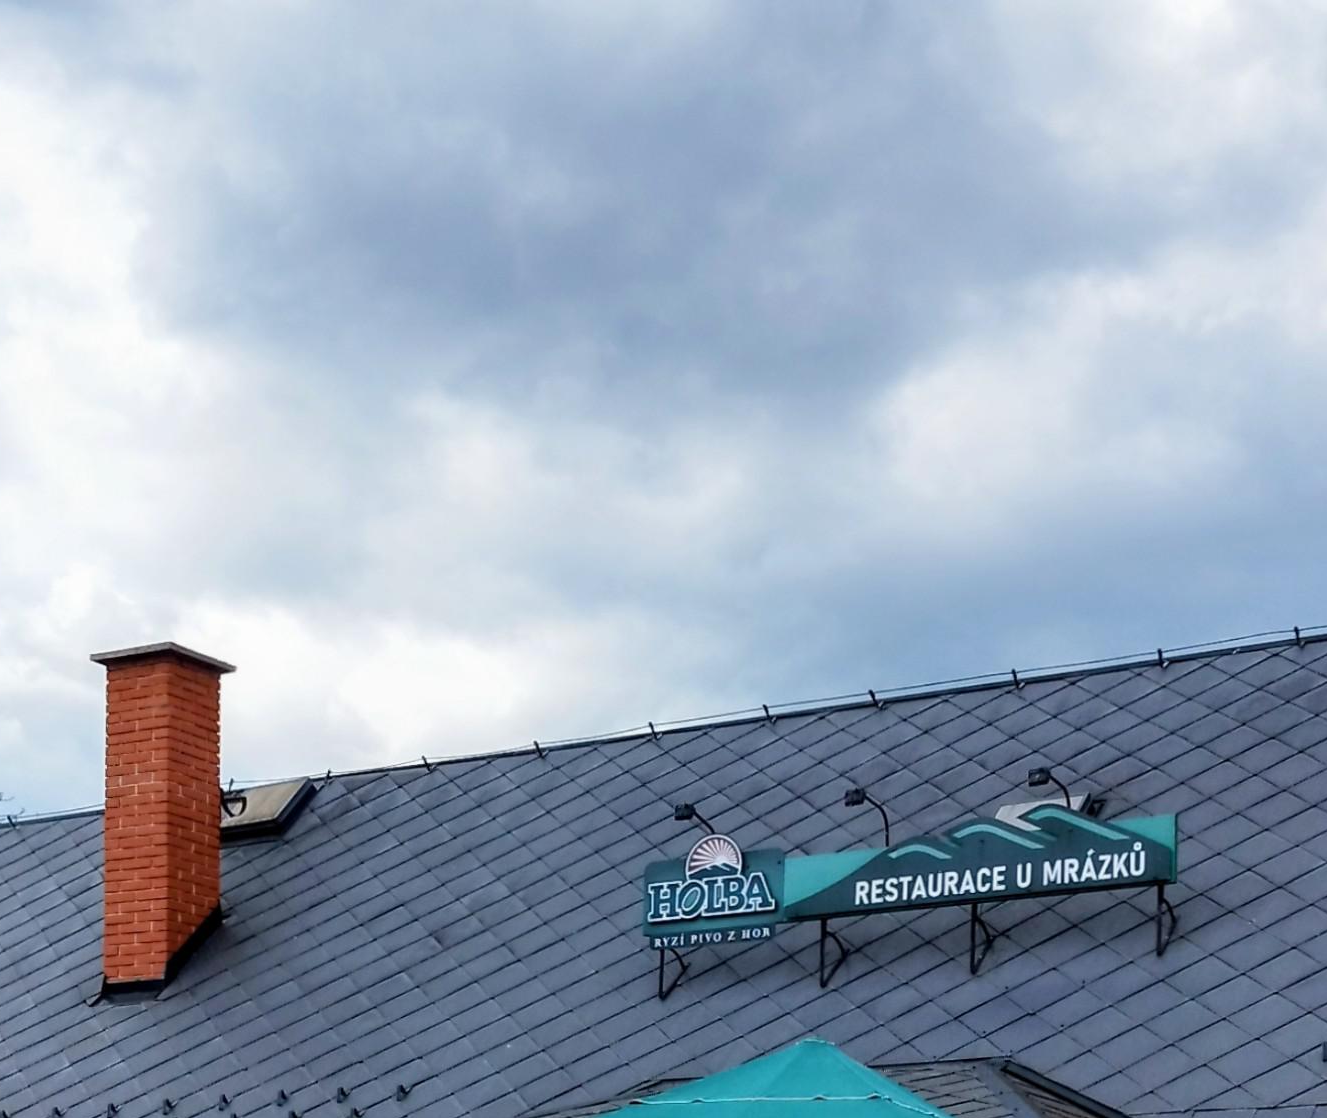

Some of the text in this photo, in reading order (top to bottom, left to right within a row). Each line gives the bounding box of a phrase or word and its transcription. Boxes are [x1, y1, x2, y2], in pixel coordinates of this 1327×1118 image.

[647, 872, 775, 922] HOLBA
[854, 841, 1147, 906] RESTAURACE U MRÁZKŮ
[653, 932, 686, 948] RYZÍ
[689, 930, 723, 945] PIVO
[727, 930, 737, 941] Z
